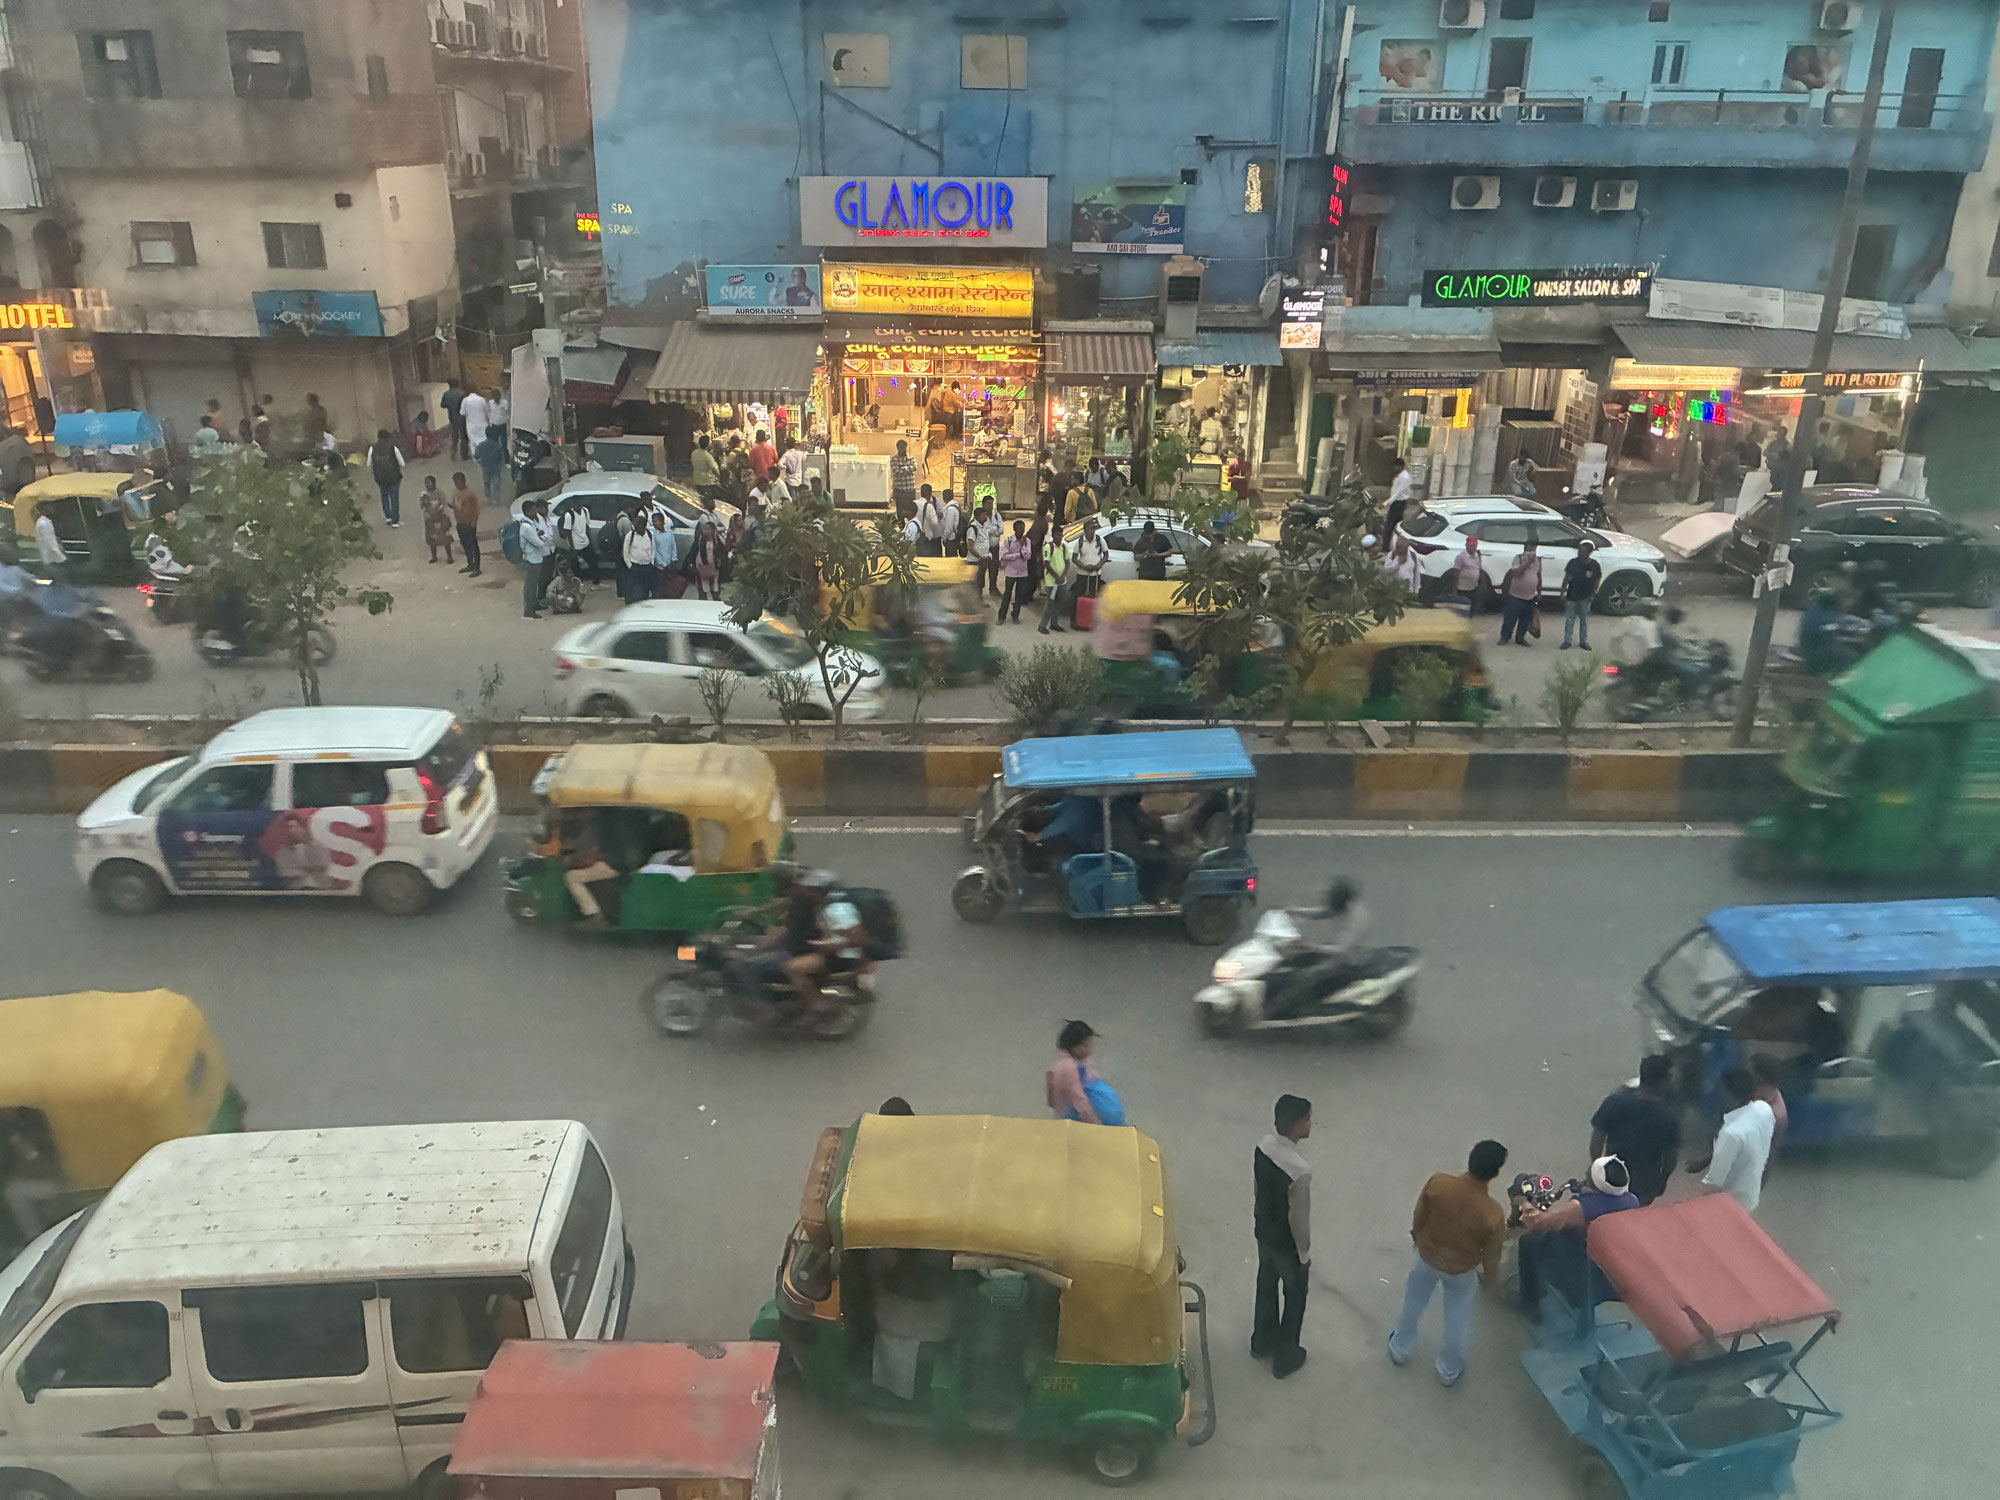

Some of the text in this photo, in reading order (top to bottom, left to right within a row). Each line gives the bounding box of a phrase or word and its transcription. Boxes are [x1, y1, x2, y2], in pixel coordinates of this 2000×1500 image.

[1414, 102, 1545, 121] THE RIL
[1333, 165, 1349, 184] SALON
[835, 180, 1014, 228] GLAMOUR
[1329, 194, 1343, 217] SPA
[577, 219, 601, 232] SPA
[720, 284, 757, 300] SURE
[861, 283, 904, 303] खाटू
[907, 284, 955, 300] श्याम
[1436, 274, 1532, 298] GLAMOUR
[1534, 281, 1572, 297] UNISEX
[1573, 279, 1611, 297] SALON
[1611, 279, 1620, 296] &
[1622, 279, 1641, 296] SPA
[320, 311, 361, 320] JOCKEY
